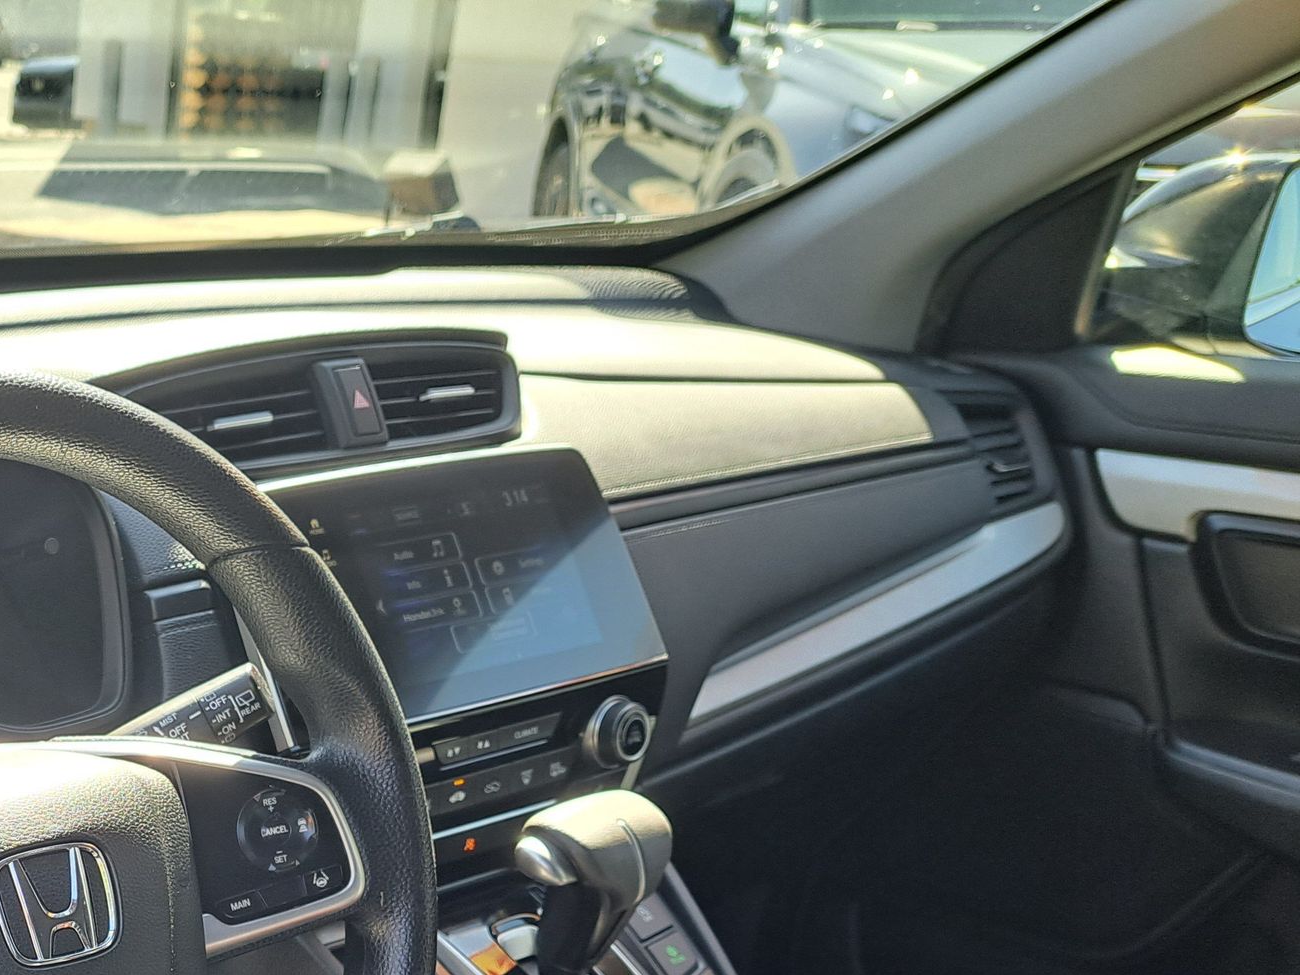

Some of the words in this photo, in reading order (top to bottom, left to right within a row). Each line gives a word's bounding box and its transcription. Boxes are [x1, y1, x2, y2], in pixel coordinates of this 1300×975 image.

[240, 702, 261, 718] REAR
[159, 712, 177, 728] MIST
[169, 722, 187, 738] OFF
[262, 797, 277, 807] RES
[260, 824, 289, 838] CANCEL
[274, 854, 288, 864] SET
[230, 897, 251, 912] MAIN
